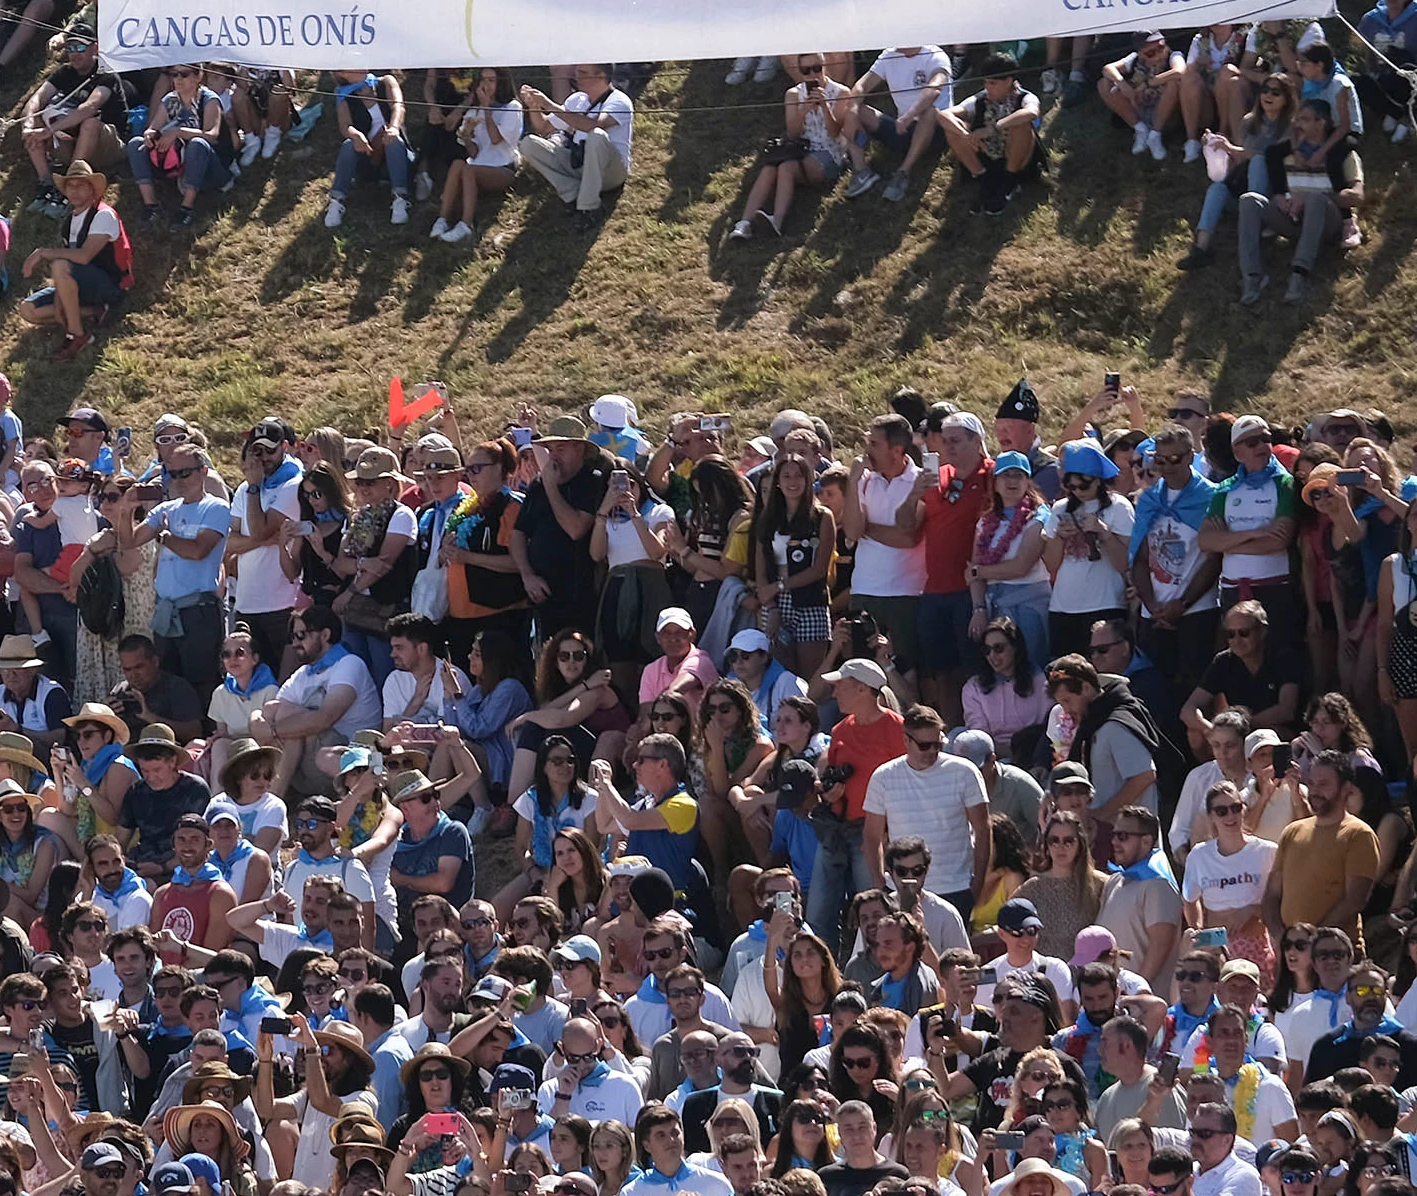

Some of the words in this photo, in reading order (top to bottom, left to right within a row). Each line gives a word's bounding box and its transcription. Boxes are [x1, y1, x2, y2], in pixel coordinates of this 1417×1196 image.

[115, 15, 250, 48] CANGAS
[253, 14, 294, 47] DE
[300, 5, 377, 47] ONÍS
[1201, 873, 1261, 889] Empathy
